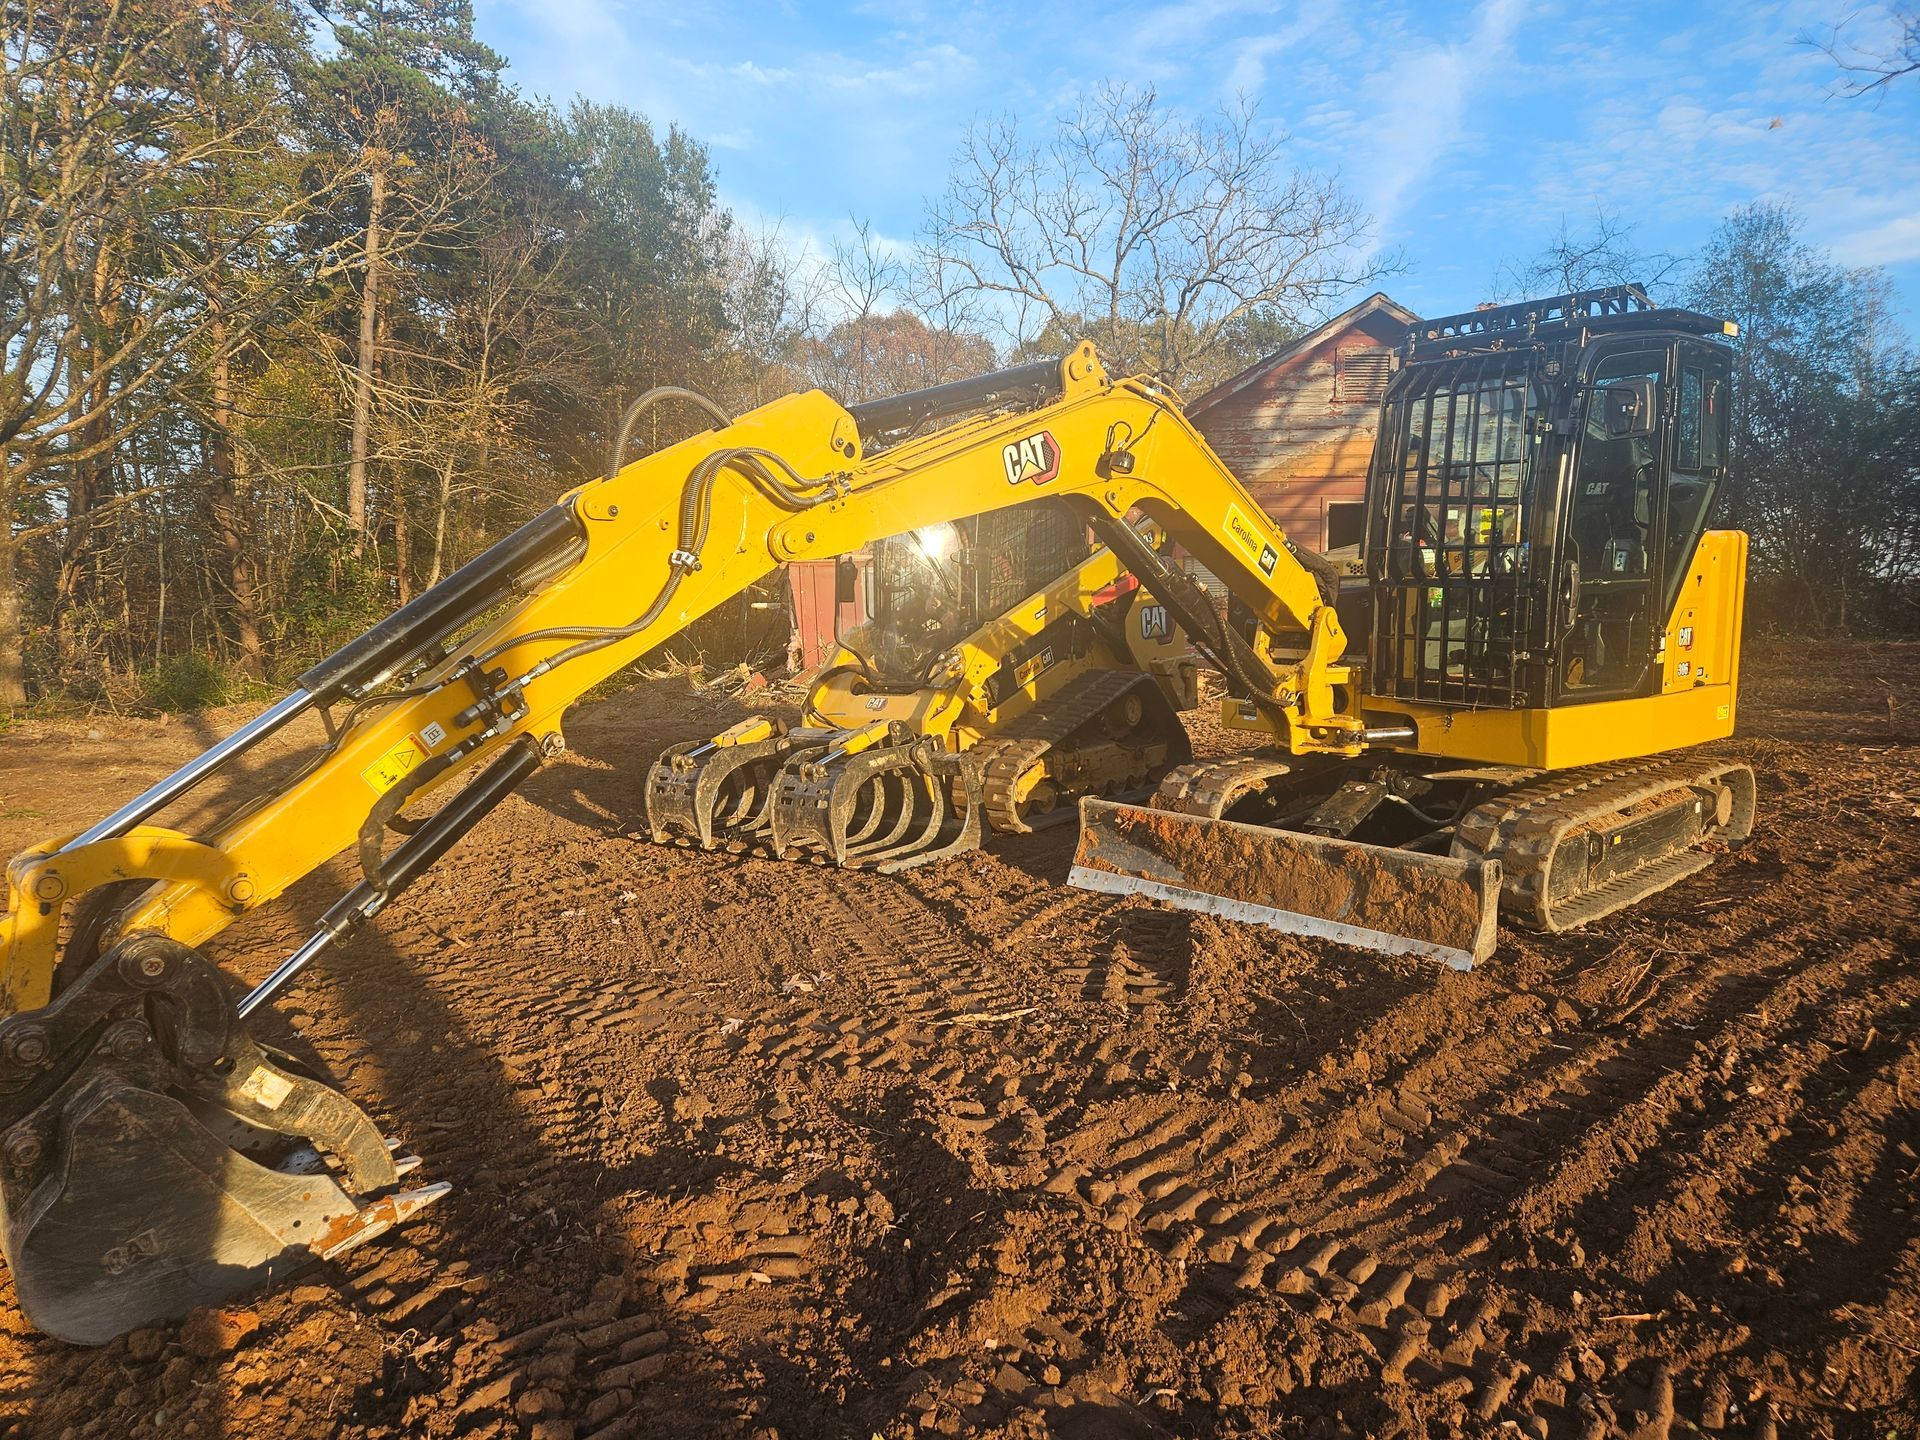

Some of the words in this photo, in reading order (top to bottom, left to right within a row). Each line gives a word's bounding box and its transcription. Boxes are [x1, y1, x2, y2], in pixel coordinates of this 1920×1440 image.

[1003, 432, 1048, 484] CAT
[1586, 482, 1610, 496] CAT
[1231, 516, 1258, 552] Carolina
[1260, 549, 1276, 570] CAT
[1141, 606, 1167, 638] CAT
[1678, 627, 1693, 647] CAT
[1042, 651, 1052, 665] CAT
[866, 697, 886, 709] CAT
